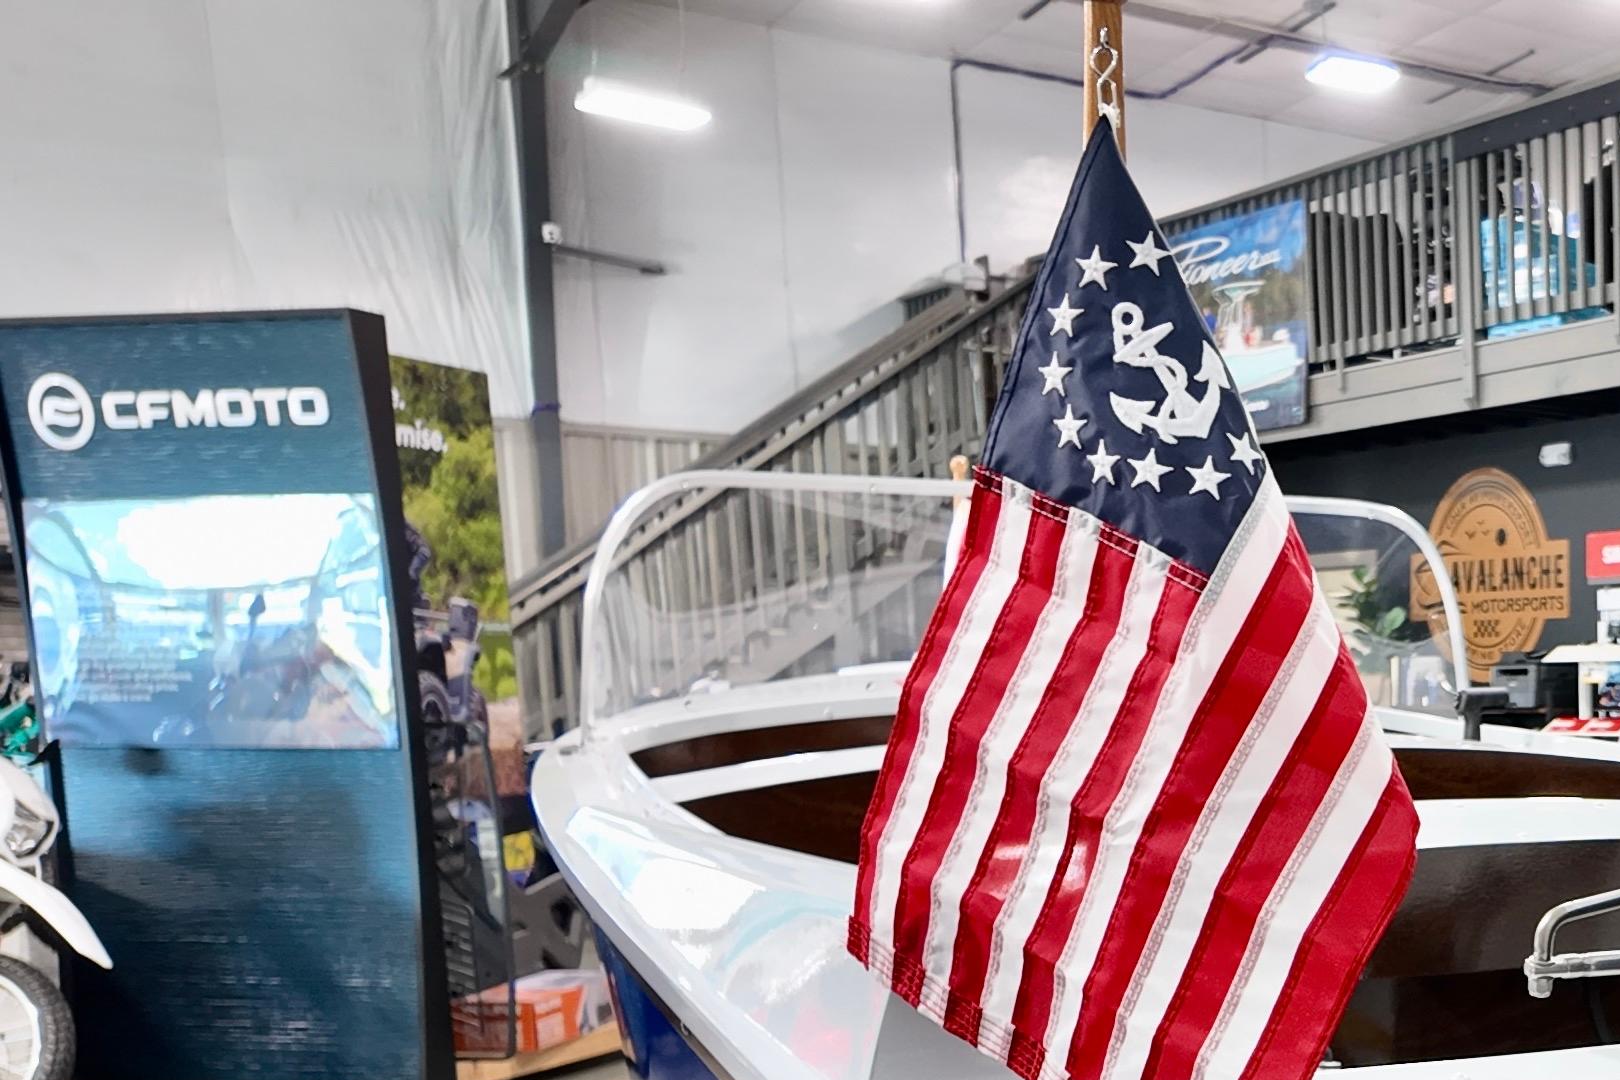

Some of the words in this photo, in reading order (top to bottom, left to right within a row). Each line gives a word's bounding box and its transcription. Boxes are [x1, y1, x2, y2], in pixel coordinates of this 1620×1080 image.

[101, 386, 330, 430] CFMOTO
[1451, 554, 1564, 594] AVALANCHE
[1471, 595, 1565, 614] MOTORSPORTS
